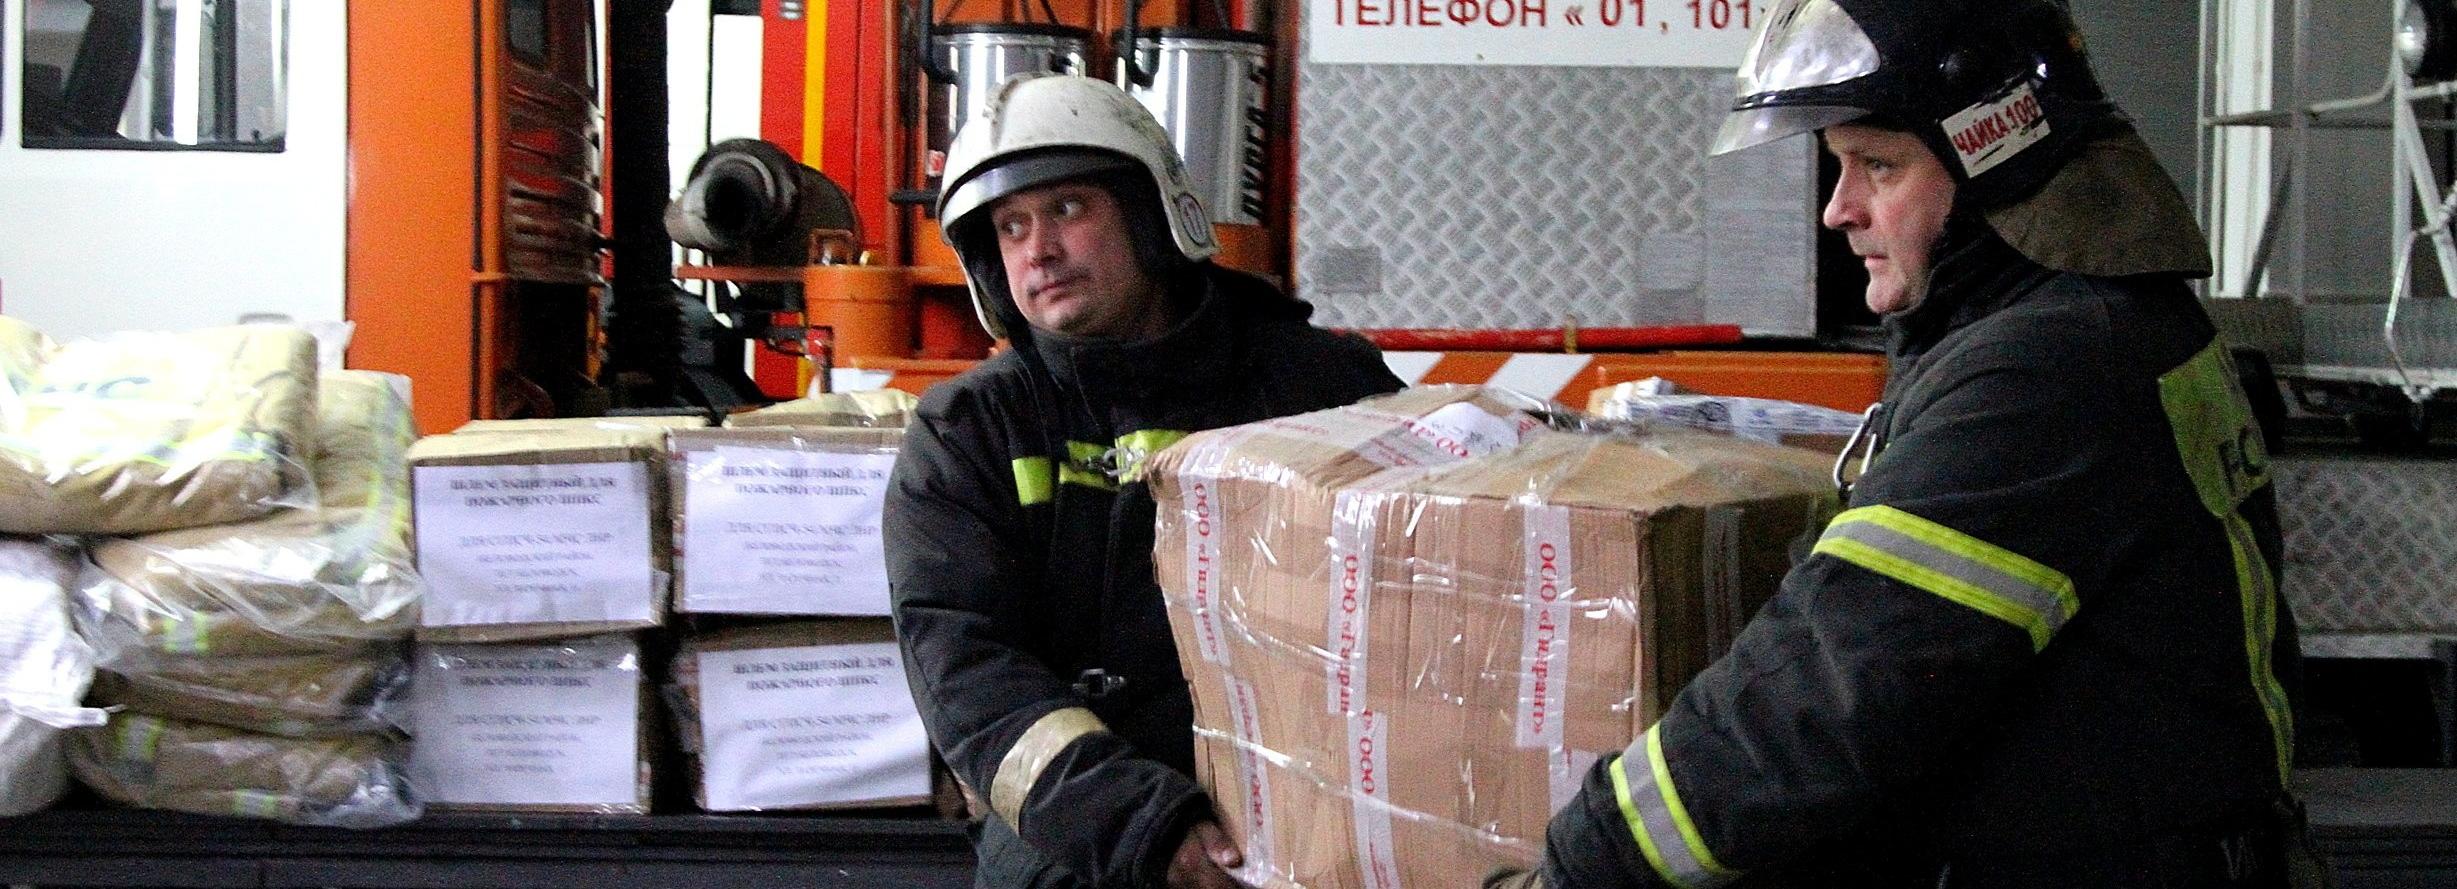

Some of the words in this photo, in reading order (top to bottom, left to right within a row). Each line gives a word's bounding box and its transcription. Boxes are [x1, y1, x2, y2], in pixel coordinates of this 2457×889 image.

[1334, 0, 1547, 27] ТЕЛЕФОН
[1952, 111, 2011, 155] ЧАЙКА
[1194, 483, 1210, 537] ООО
[1343, 554, 1358, 614] ООО
[1540, 542, 1557, 603] ООО
[1360, 738, 1375, 794] ООО
